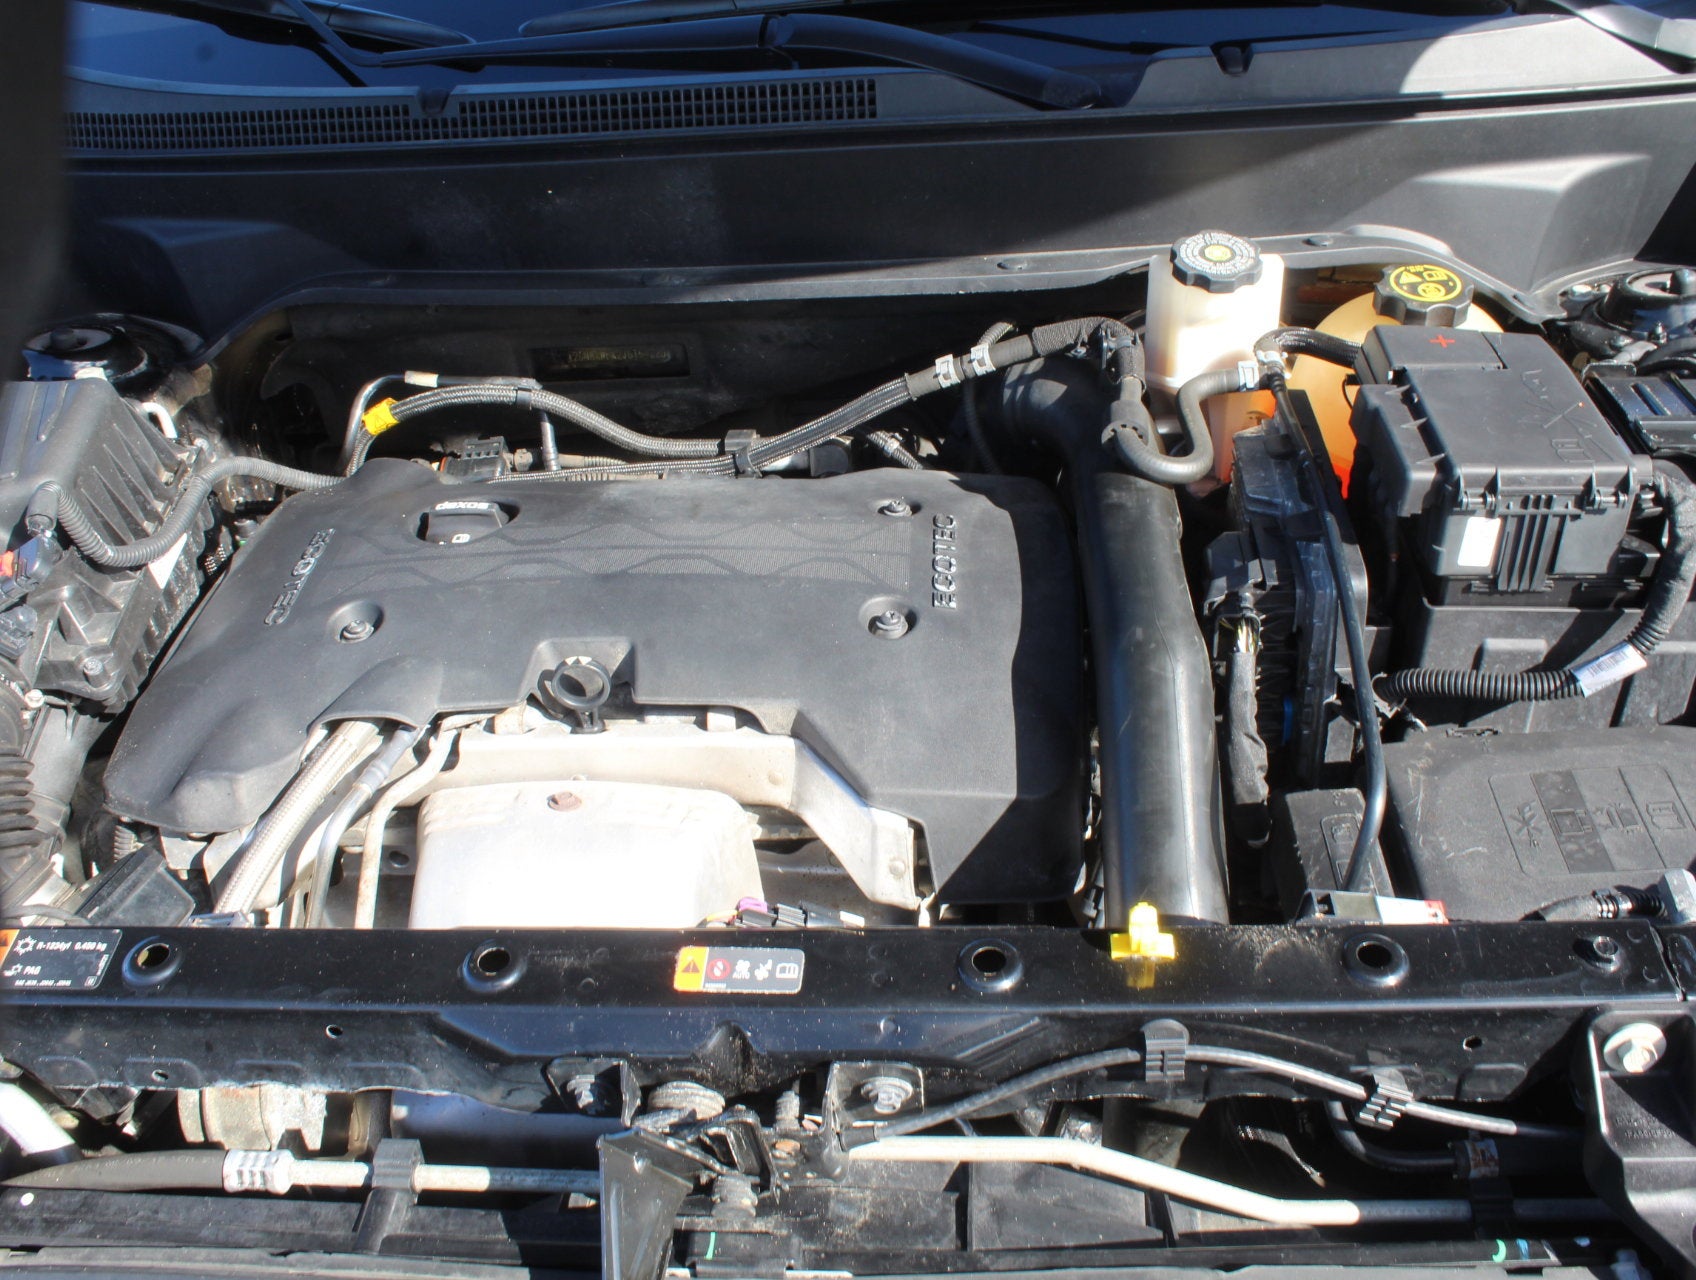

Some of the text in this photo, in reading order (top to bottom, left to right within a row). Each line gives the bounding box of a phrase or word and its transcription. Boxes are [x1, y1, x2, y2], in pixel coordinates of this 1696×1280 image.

[435, 501, 489, 510] dexos
[264, 527, 336, 626] ECOTEC
[932, 512, 957, 609] ECOTEC
[732, 971, 750, 980] AUTO
